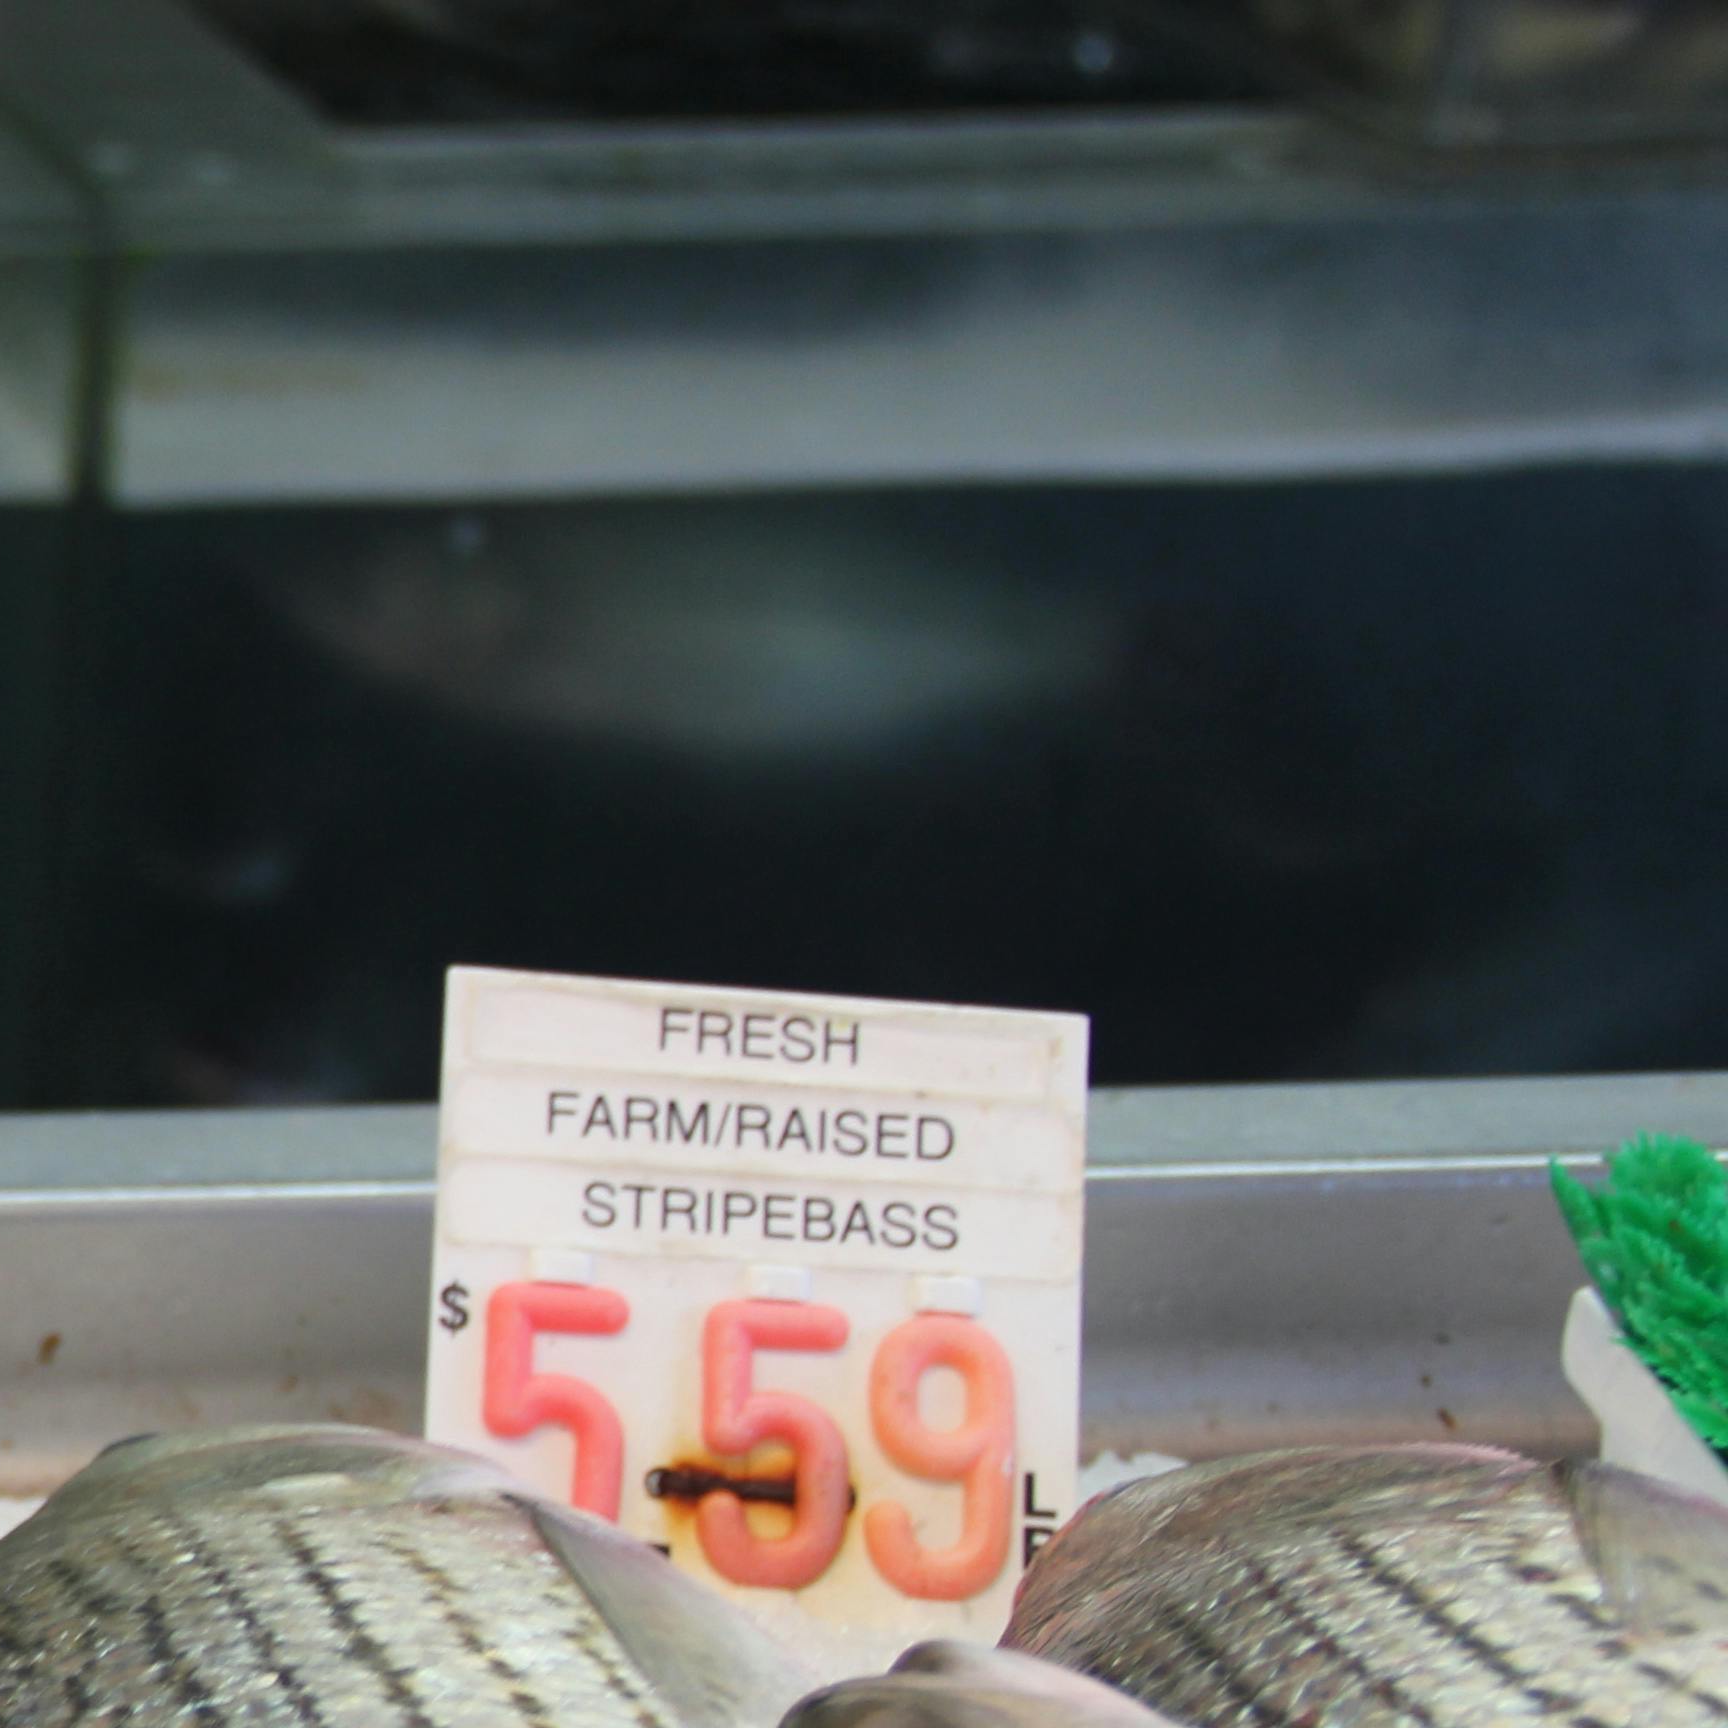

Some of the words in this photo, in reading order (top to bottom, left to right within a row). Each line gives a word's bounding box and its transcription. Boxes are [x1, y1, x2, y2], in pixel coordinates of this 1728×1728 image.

[657, 1005, 861, 1065] FRESH
[546, 1090, 956, 1162] FARM/RAISED
[582, 1181, 961, 1250] STRIPEBASS
